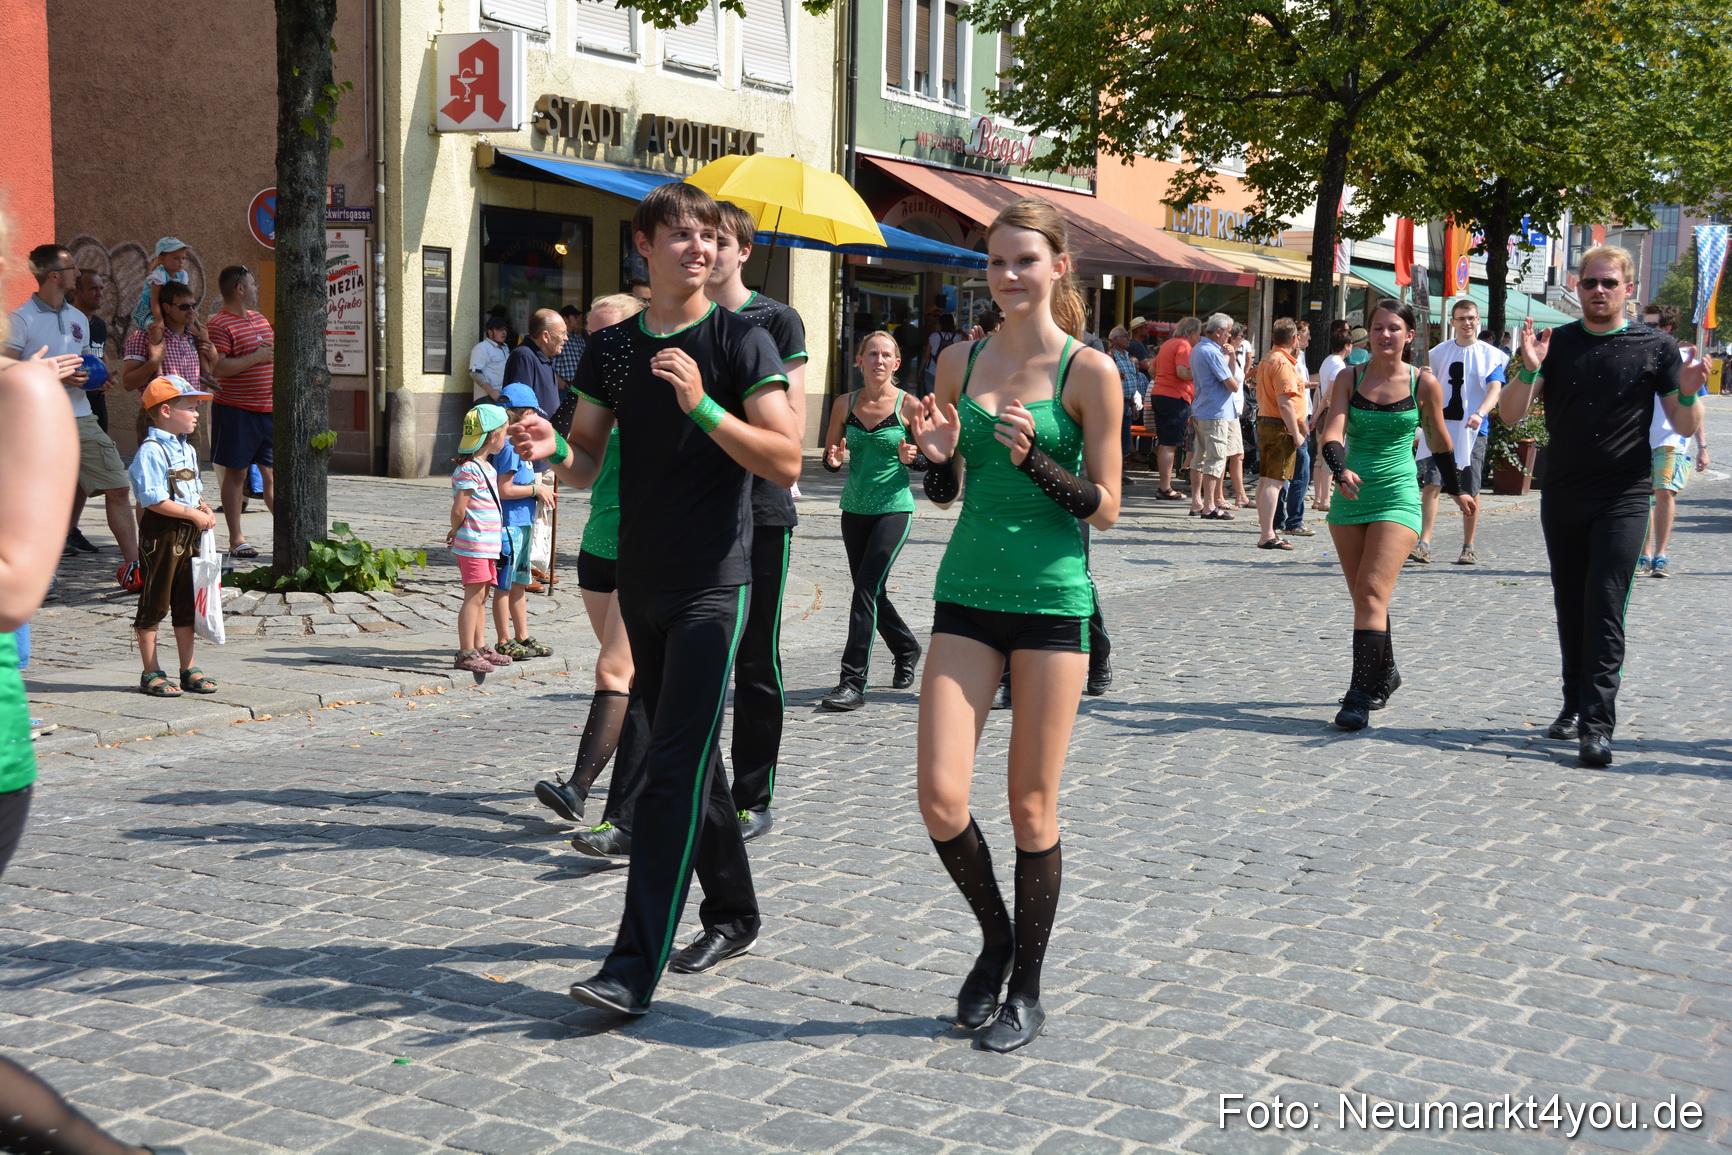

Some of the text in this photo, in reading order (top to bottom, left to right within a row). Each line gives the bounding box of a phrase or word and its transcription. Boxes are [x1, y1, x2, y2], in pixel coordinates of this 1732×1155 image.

[545, 94, 764, 161] STADT APOTHEKE
[917, 116, 1036, 168] METZGEREI Bögerl
[1173, 203, 1212, 237] LEDER
[326, 274, 364, 297] NEZIA
